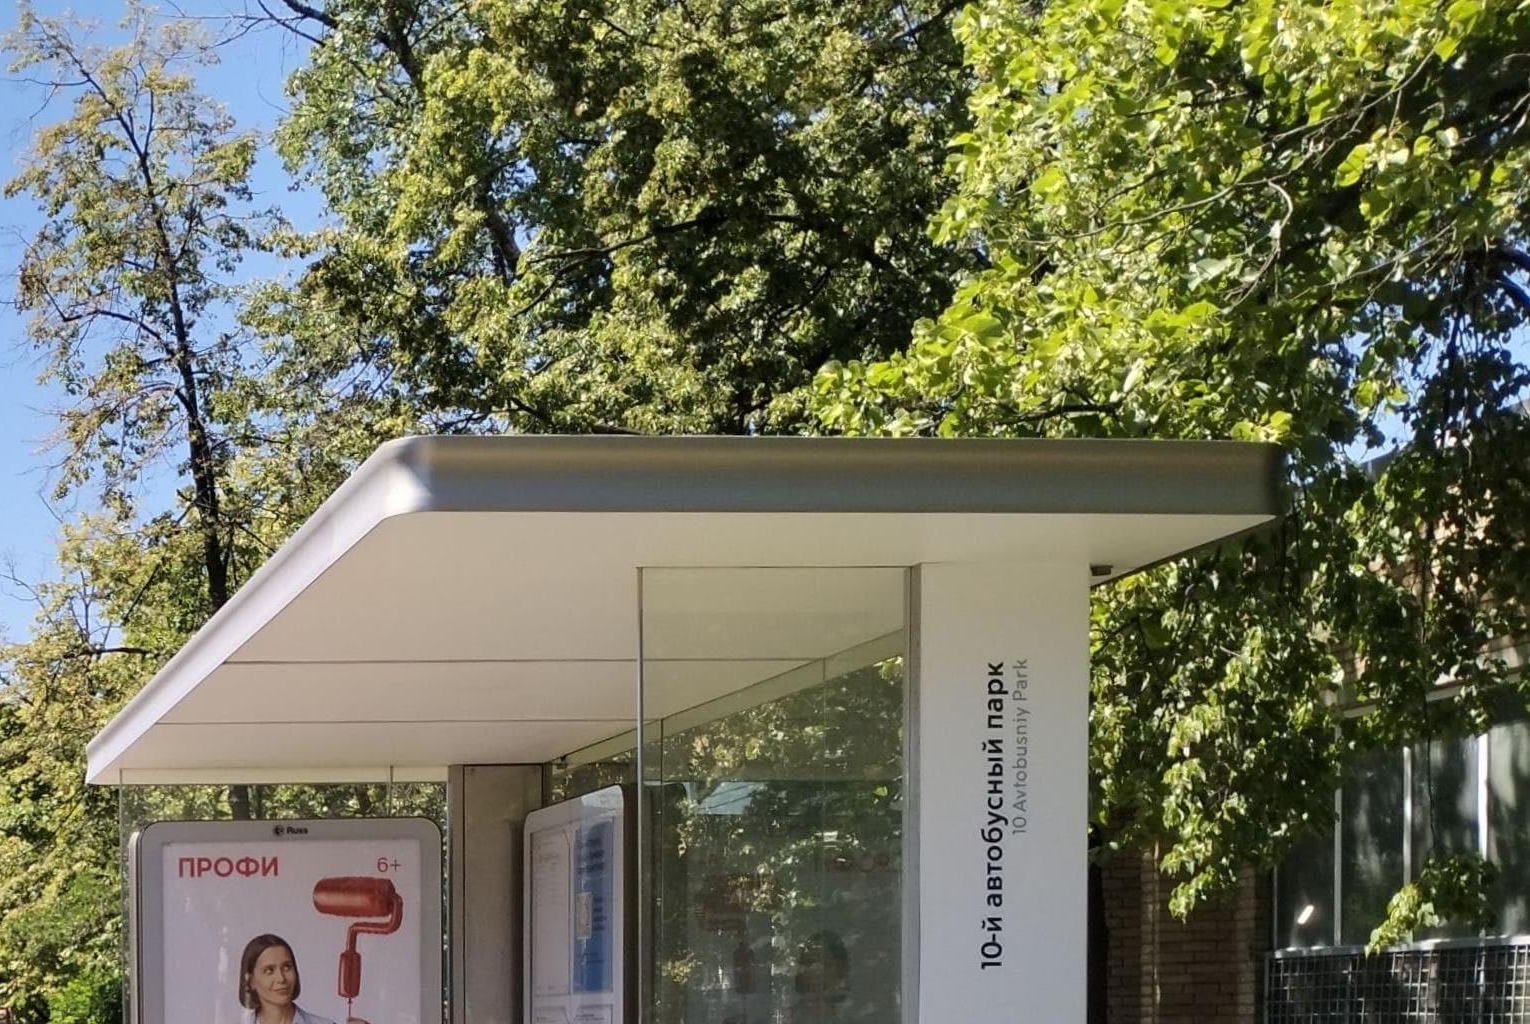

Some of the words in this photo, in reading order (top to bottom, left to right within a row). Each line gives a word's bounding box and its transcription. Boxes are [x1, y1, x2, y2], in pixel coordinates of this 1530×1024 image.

[987, 661, 1009, 730] парк
[1012, 658, 1028, 701] Park
[1012, 707, 1031, 812] Avtobusniy
[286, 826, 309, 835] Russ
[980, 738, 1009, 908] автобусный
[1012, 816, 1027, 836] 10
[178, 856, 280, 879] ПРОФИ
[376, 857, 403, 873] 6+
[980, 916, 1003, 970] 10-й
